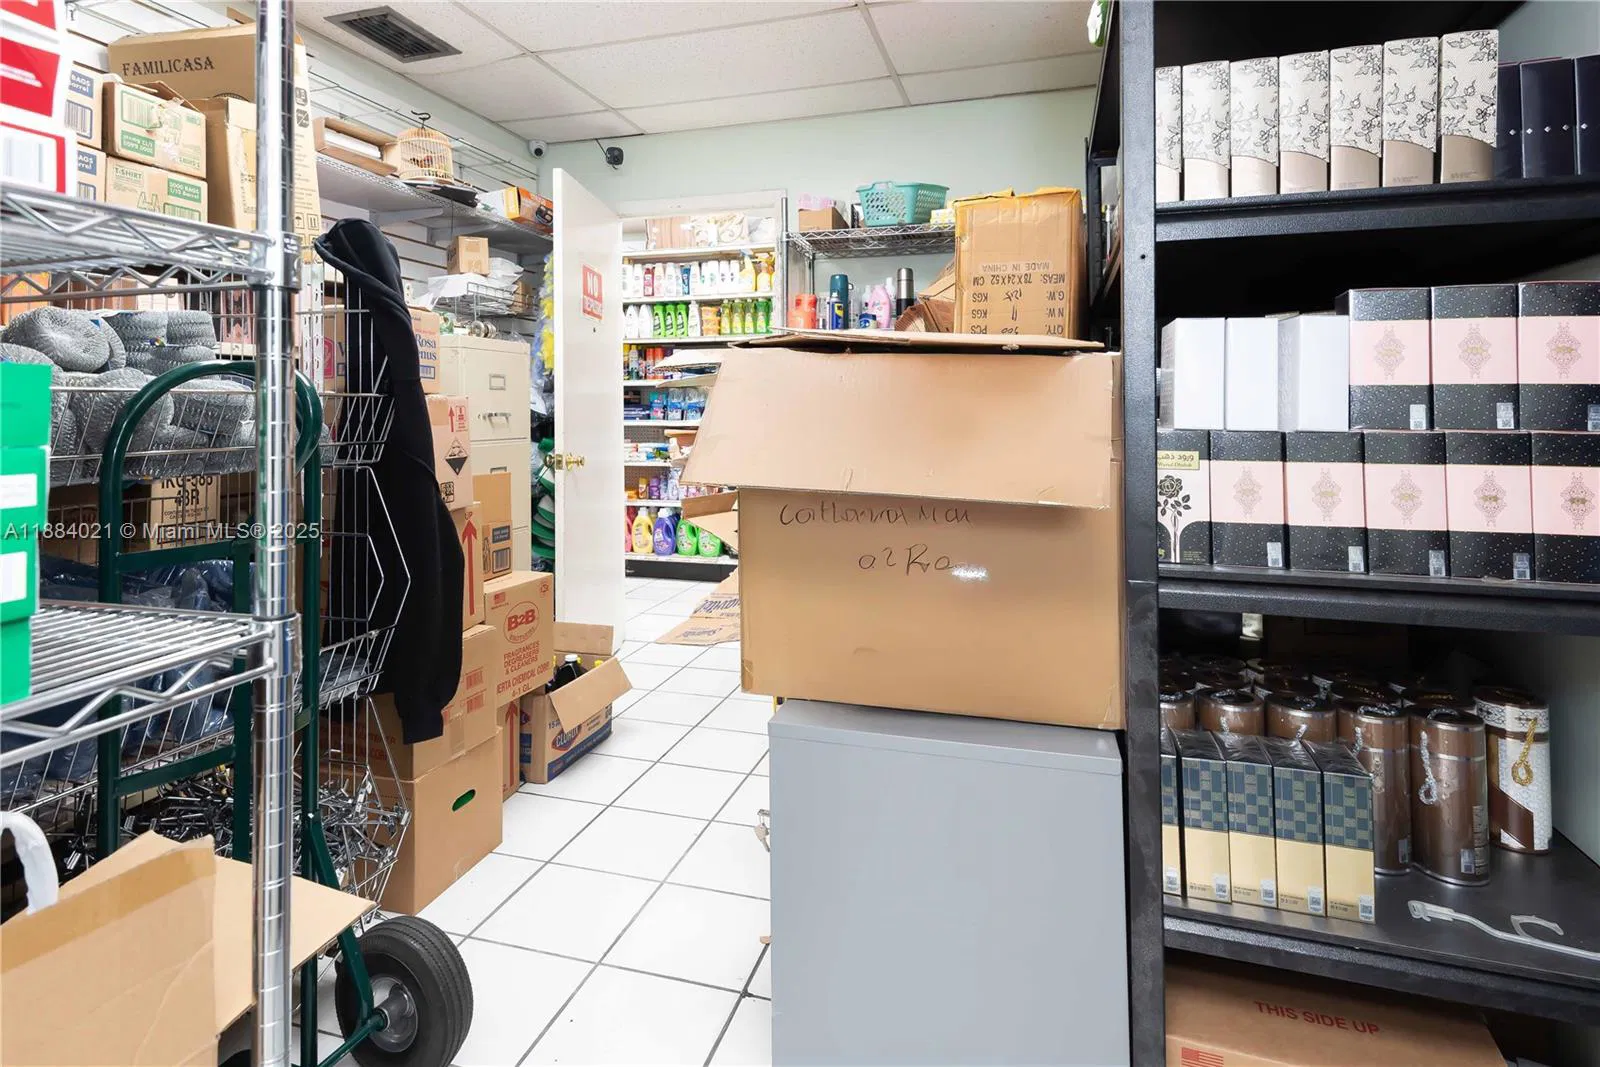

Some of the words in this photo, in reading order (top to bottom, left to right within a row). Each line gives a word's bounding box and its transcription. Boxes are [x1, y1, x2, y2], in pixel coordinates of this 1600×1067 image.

[122, 56, 215, 76] FAMILICASA
[78, 154, 93, 164] AGS
[982, 264, 1008, 273] CHINA
[1012, 263, 1020, 271] IN
[1025, 262, 1050, 271] MADE
[972, 292, 988, 303] KGS
[972, 309, 988, 319] KGS
[507, 609, 536, 632] B2B
[1254, 1001, 1298, 1020] THIS
[1303, 1011, 1348, 1030] SIDE
[1354, 1021, 1379, 1035] UP
